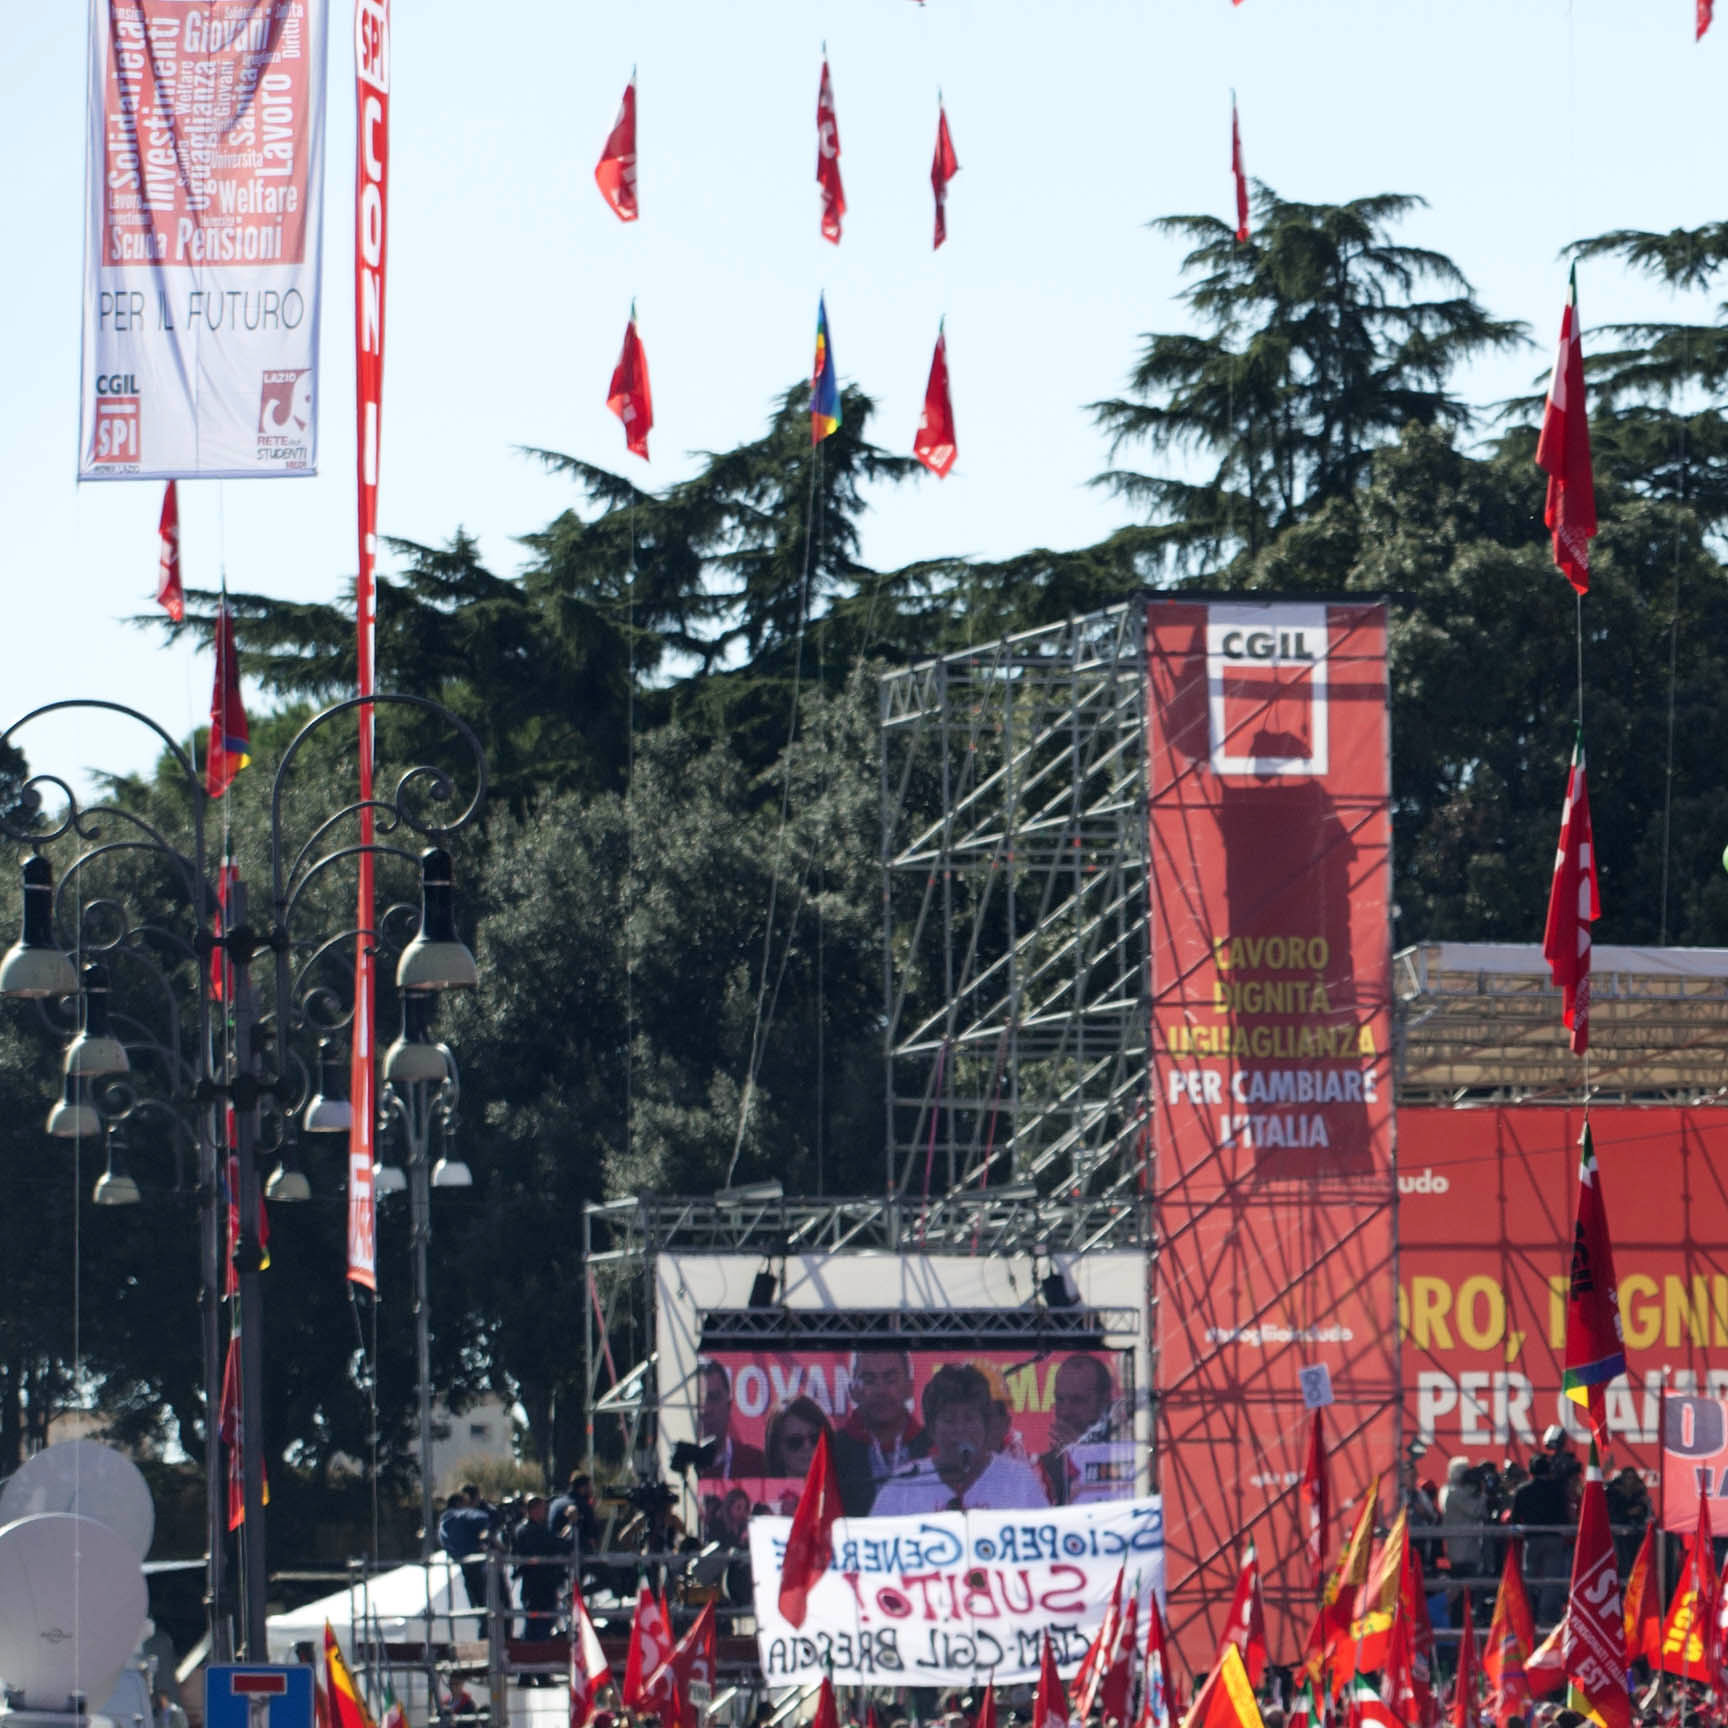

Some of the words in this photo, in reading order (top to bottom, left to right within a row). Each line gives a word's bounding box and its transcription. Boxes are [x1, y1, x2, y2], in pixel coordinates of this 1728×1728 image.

[183, 8, 272, 54] Giovani
[256, 74, 293, 177] Lavoro
[217, 179, 298, 214] Welfare
[176, 215, 283, 261] Pensioni
[100, 290, 144, 331] PER
[186, 288, 304, 331] FUTURO
[96, 373, 140, 395] CGIL
[97, 418, 138, 457] SPI
[1222, 631, 1314, 661] CGIL
[1213, 936, 1330, 970] LAVORO
[1213, 973, 1332, 1015] DIGNITÀ
[1167, 1025, 1377, 1060] UGUAGLIANZA
[1169, 1069, 1223, 1104] PER
[1231, 1069, 1379, 1104] CAMBIARE
[1220, 1113, 1330, 1149] L'ITALIA
[1418, 1370, 1537, 1448] PER
